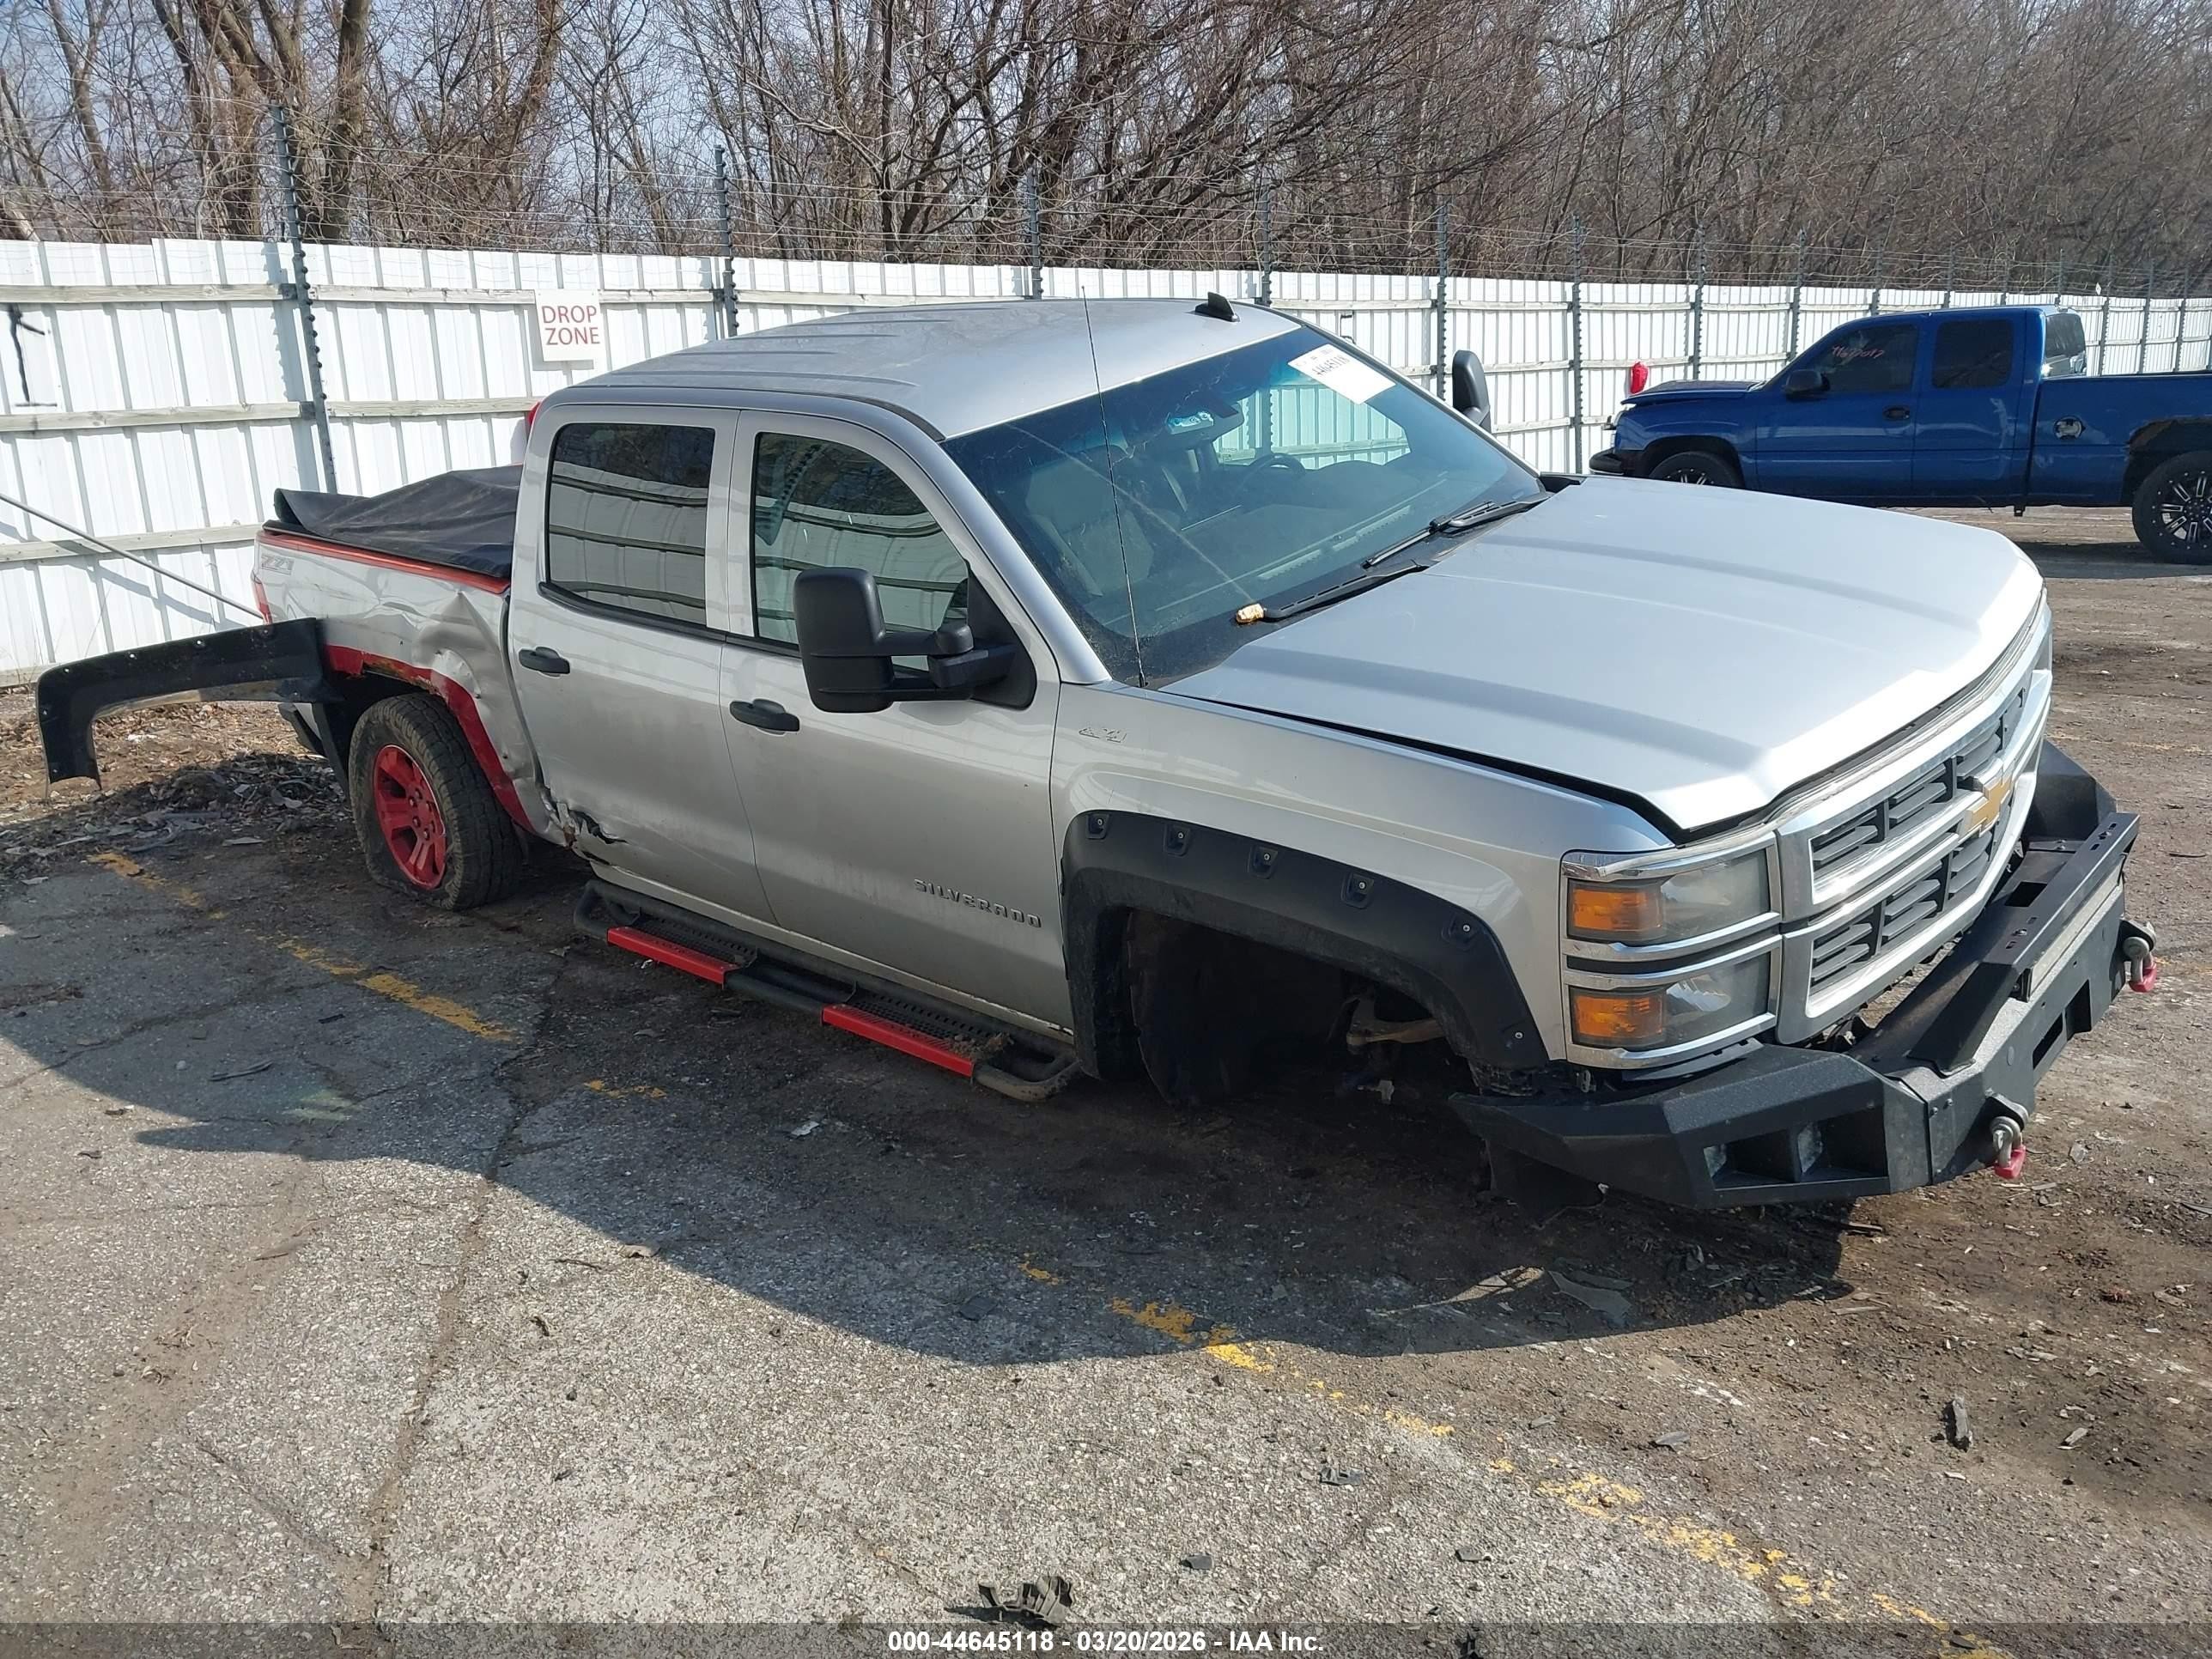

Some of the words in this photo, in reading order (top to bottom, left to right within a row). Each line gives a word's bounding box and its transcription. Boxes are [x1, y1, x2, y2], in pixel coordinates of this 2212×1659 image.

[541, 305, 597, 324] DROP
[544, 326, 601, 346] ZONE
[914, 878, 1042, 927] SILVERADO
